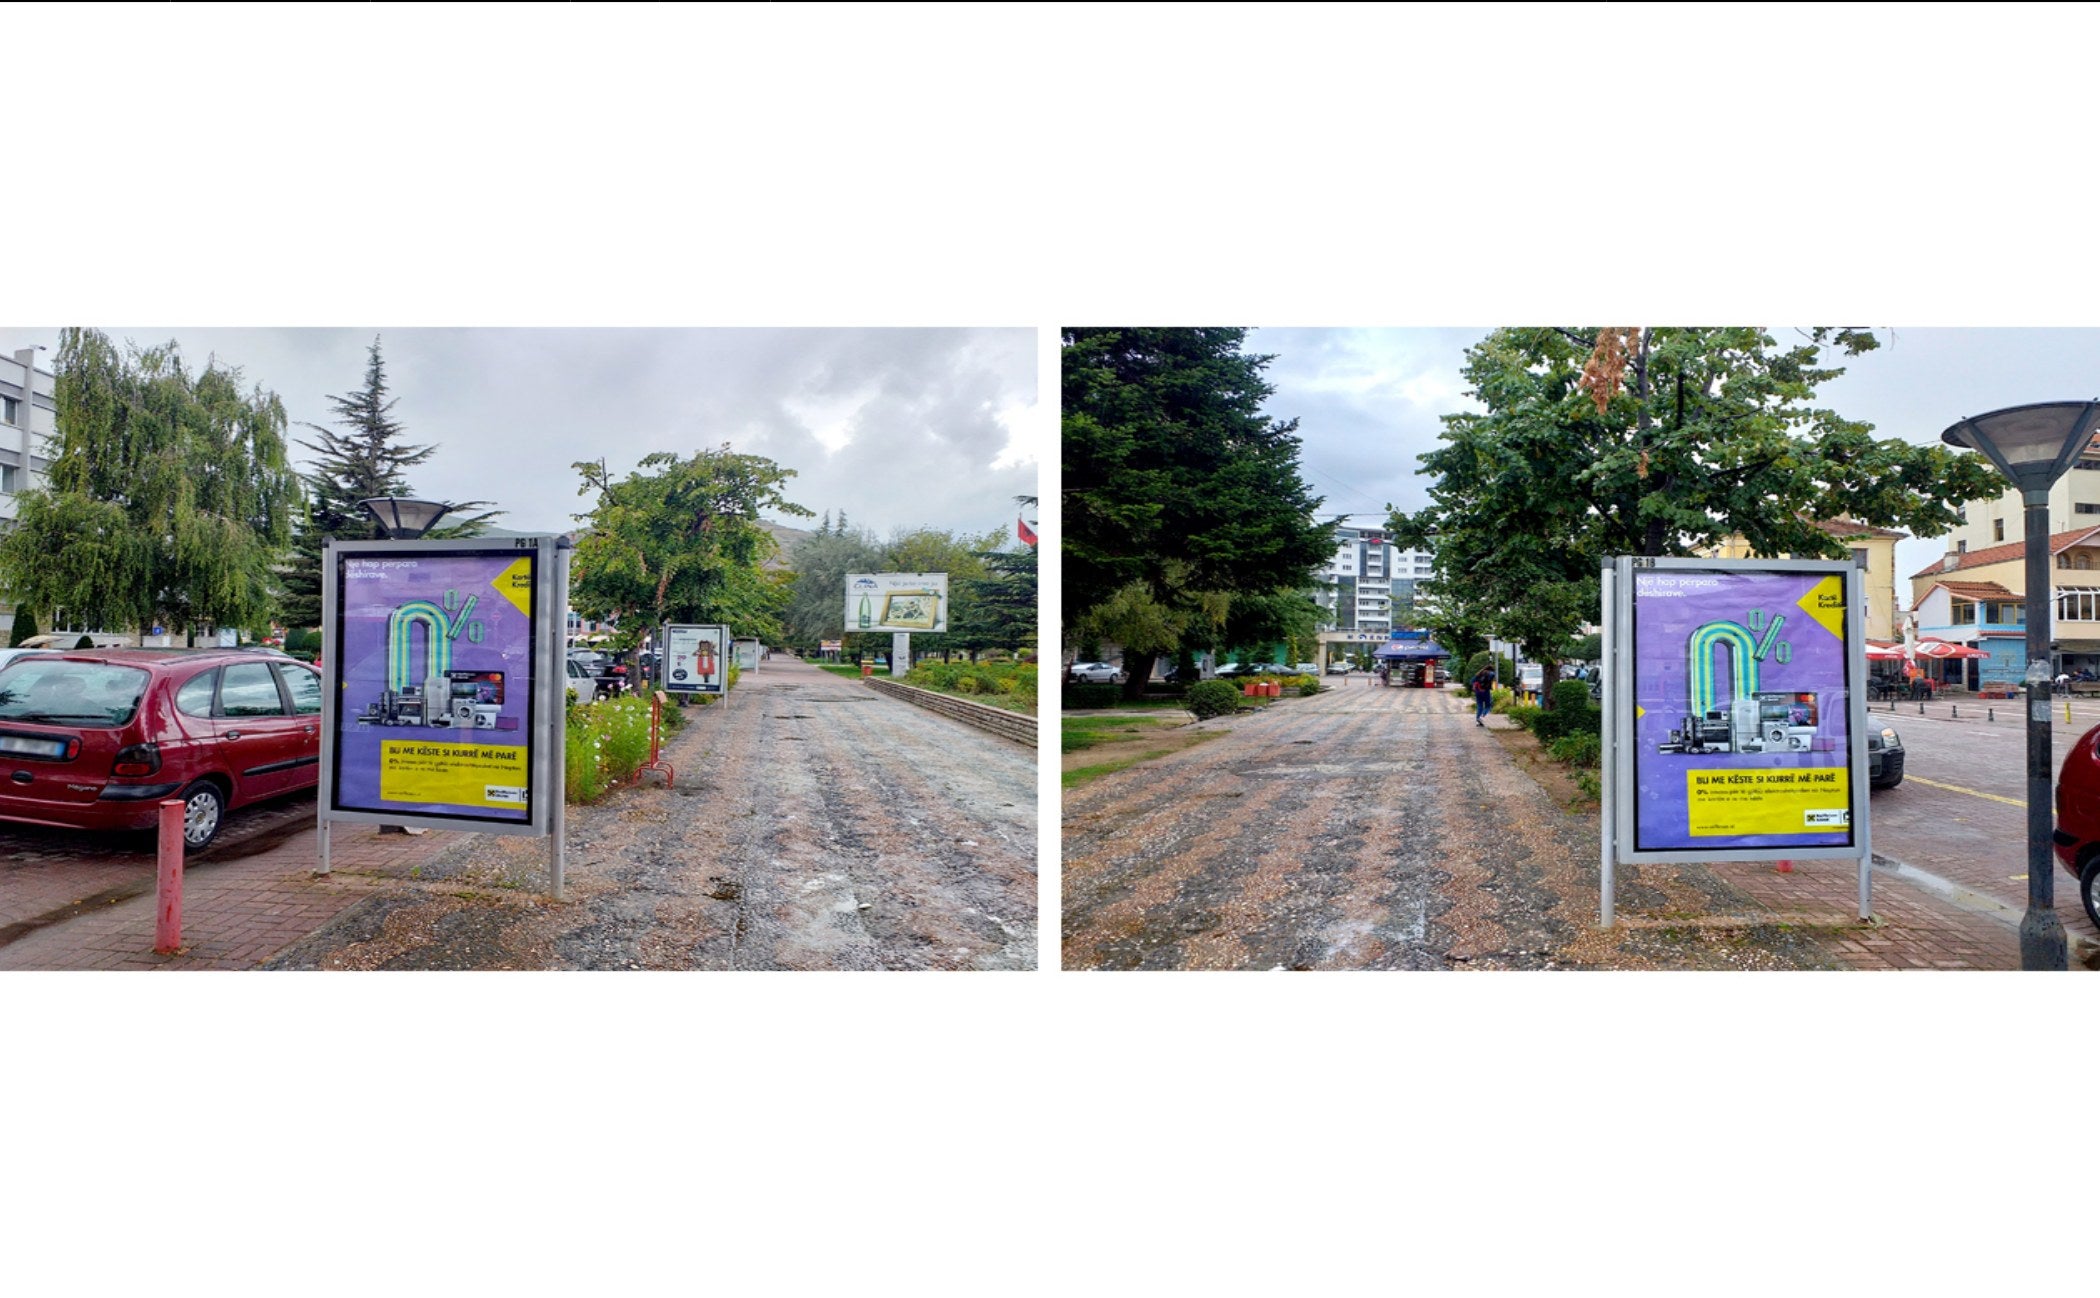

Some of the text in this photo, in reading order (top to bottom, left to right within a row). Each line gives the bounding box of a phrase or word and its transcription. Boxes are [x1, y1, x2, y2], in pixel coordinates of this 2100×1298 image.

[362, 560, 380, 569] hap
[1658, 577, 1676, 587] hap
[443, 749, 450, 758] SI
[1756, 775, 1764, 784] SI
[1813, 771, 1836, 783] PARË
